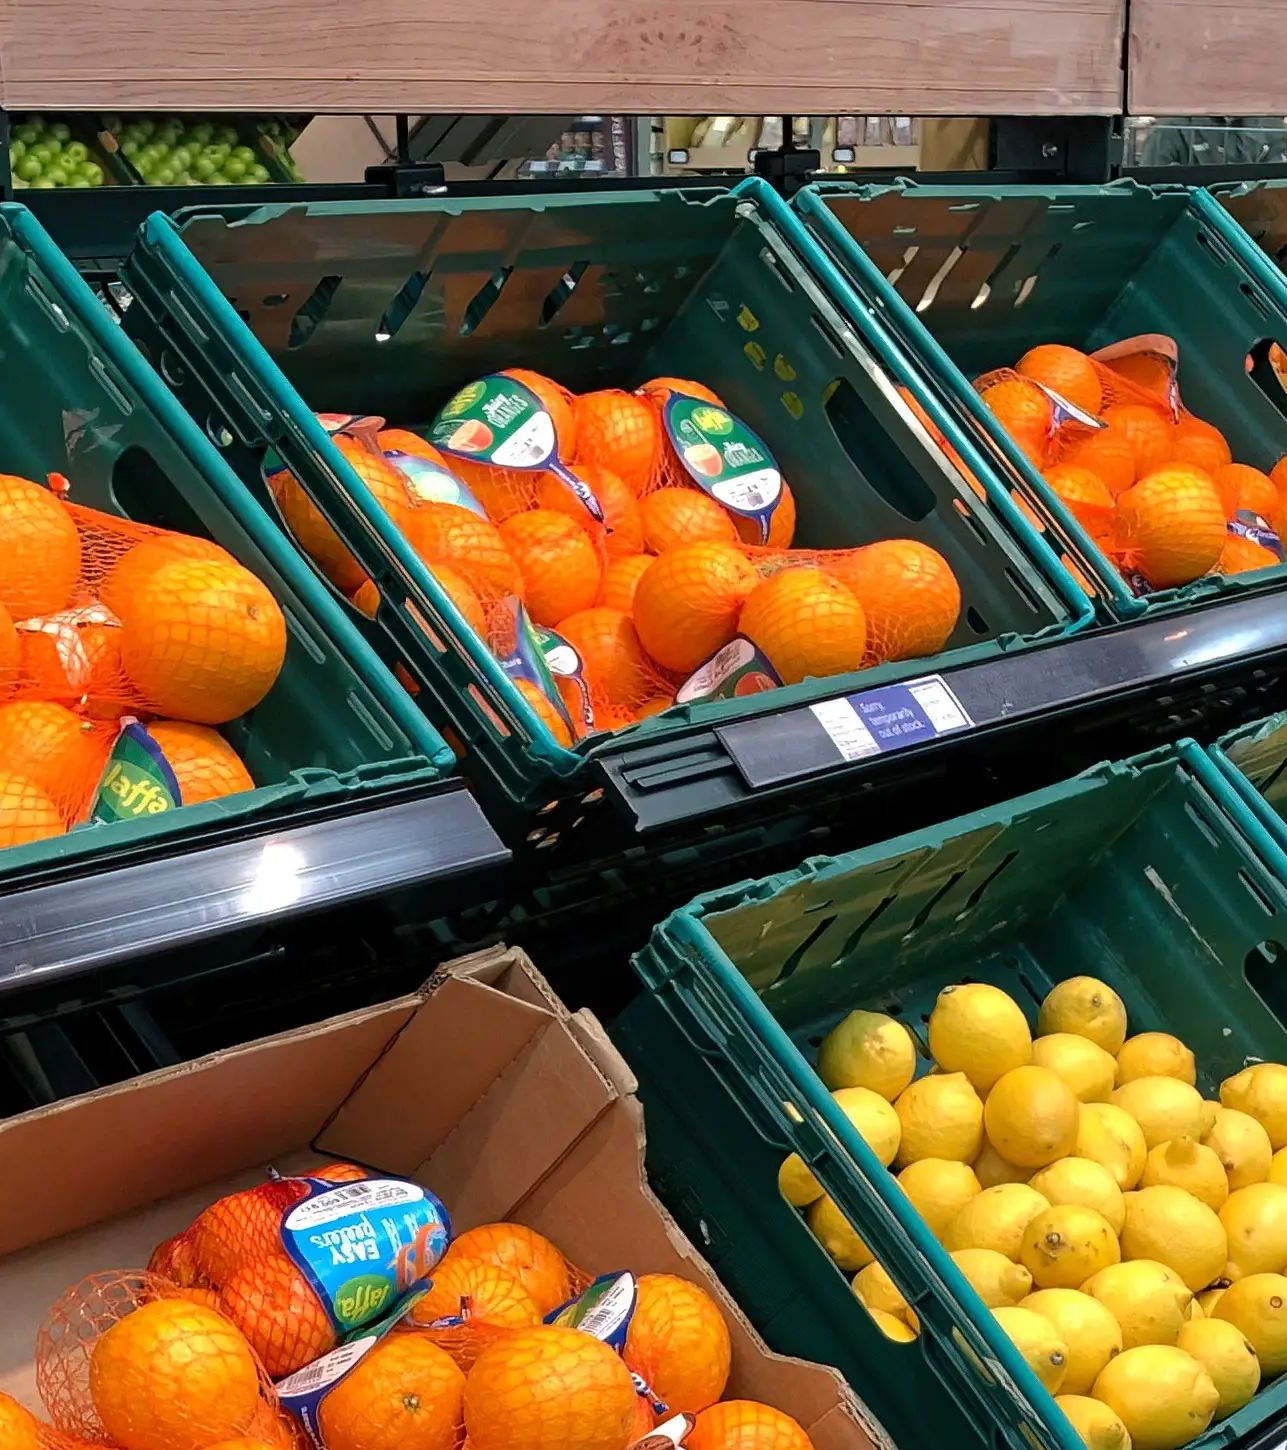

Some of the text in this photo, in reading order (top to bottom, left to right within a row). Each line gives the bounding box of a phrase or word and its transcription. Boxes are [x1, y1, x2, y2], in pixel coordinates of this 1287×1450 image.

[878, 728, 895, 741] out
[310, 1214, 377, 1249] peelers
[329, 1238, 381, 1266] EASY
